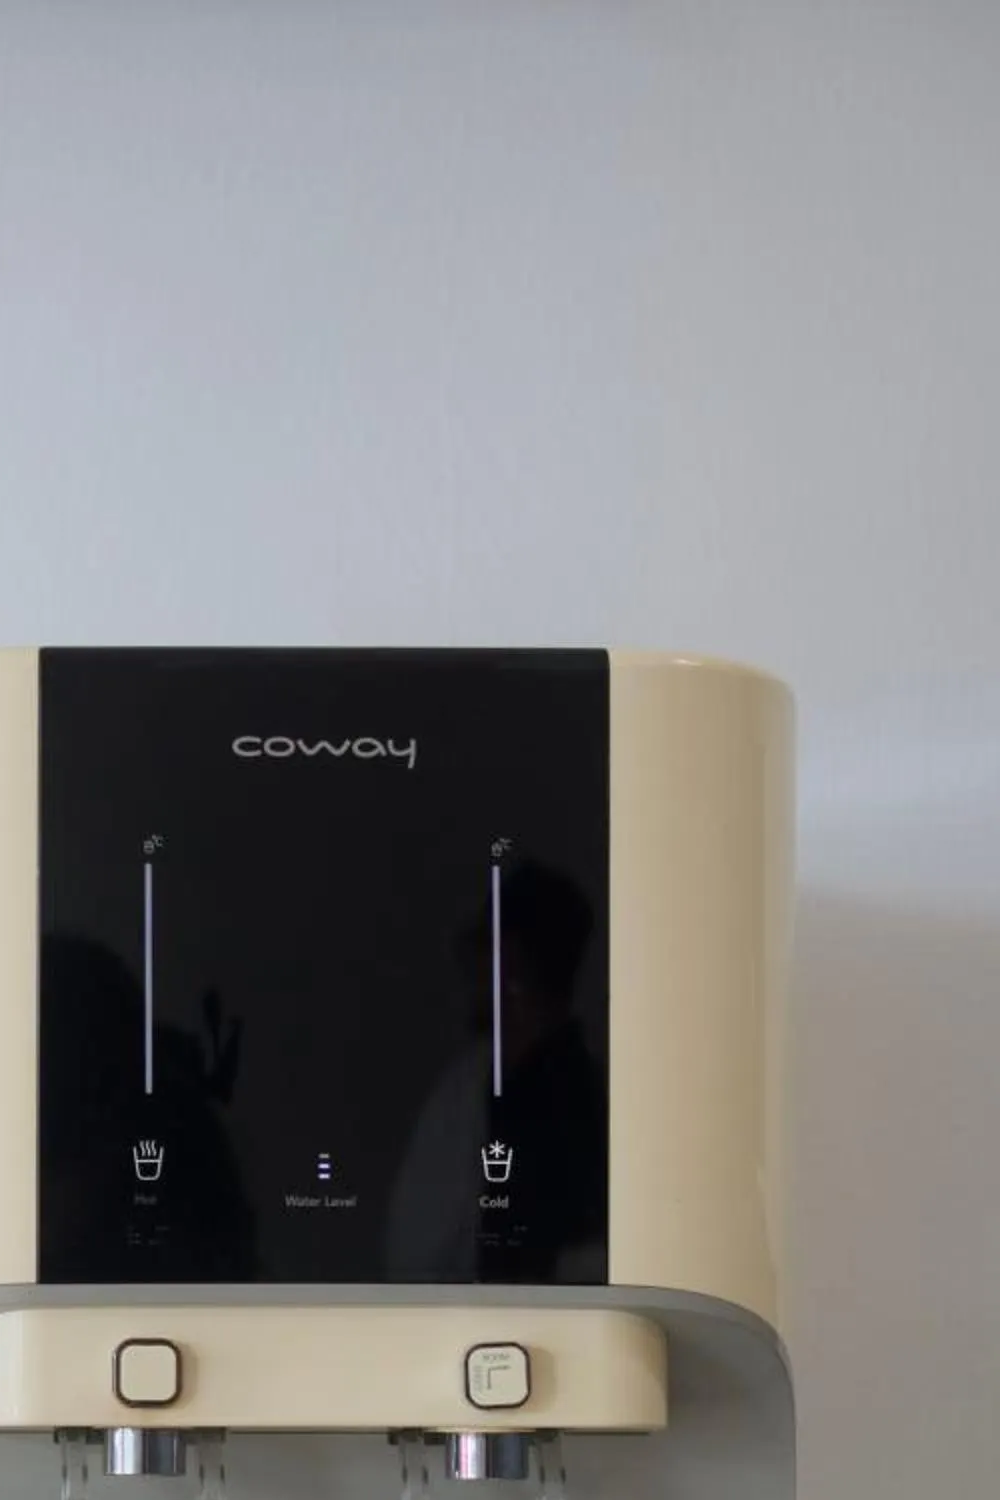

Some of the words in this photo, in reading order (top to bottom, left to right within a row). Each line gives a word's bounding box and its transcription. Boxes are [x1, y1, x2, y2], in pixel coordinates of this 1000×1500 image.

[232, 736, 416, 769] coway
[284, 1195, 321, 1208] Water
[324, 1195, 358, 1208] Level
[479, 1194, 509, 1209] Cold
